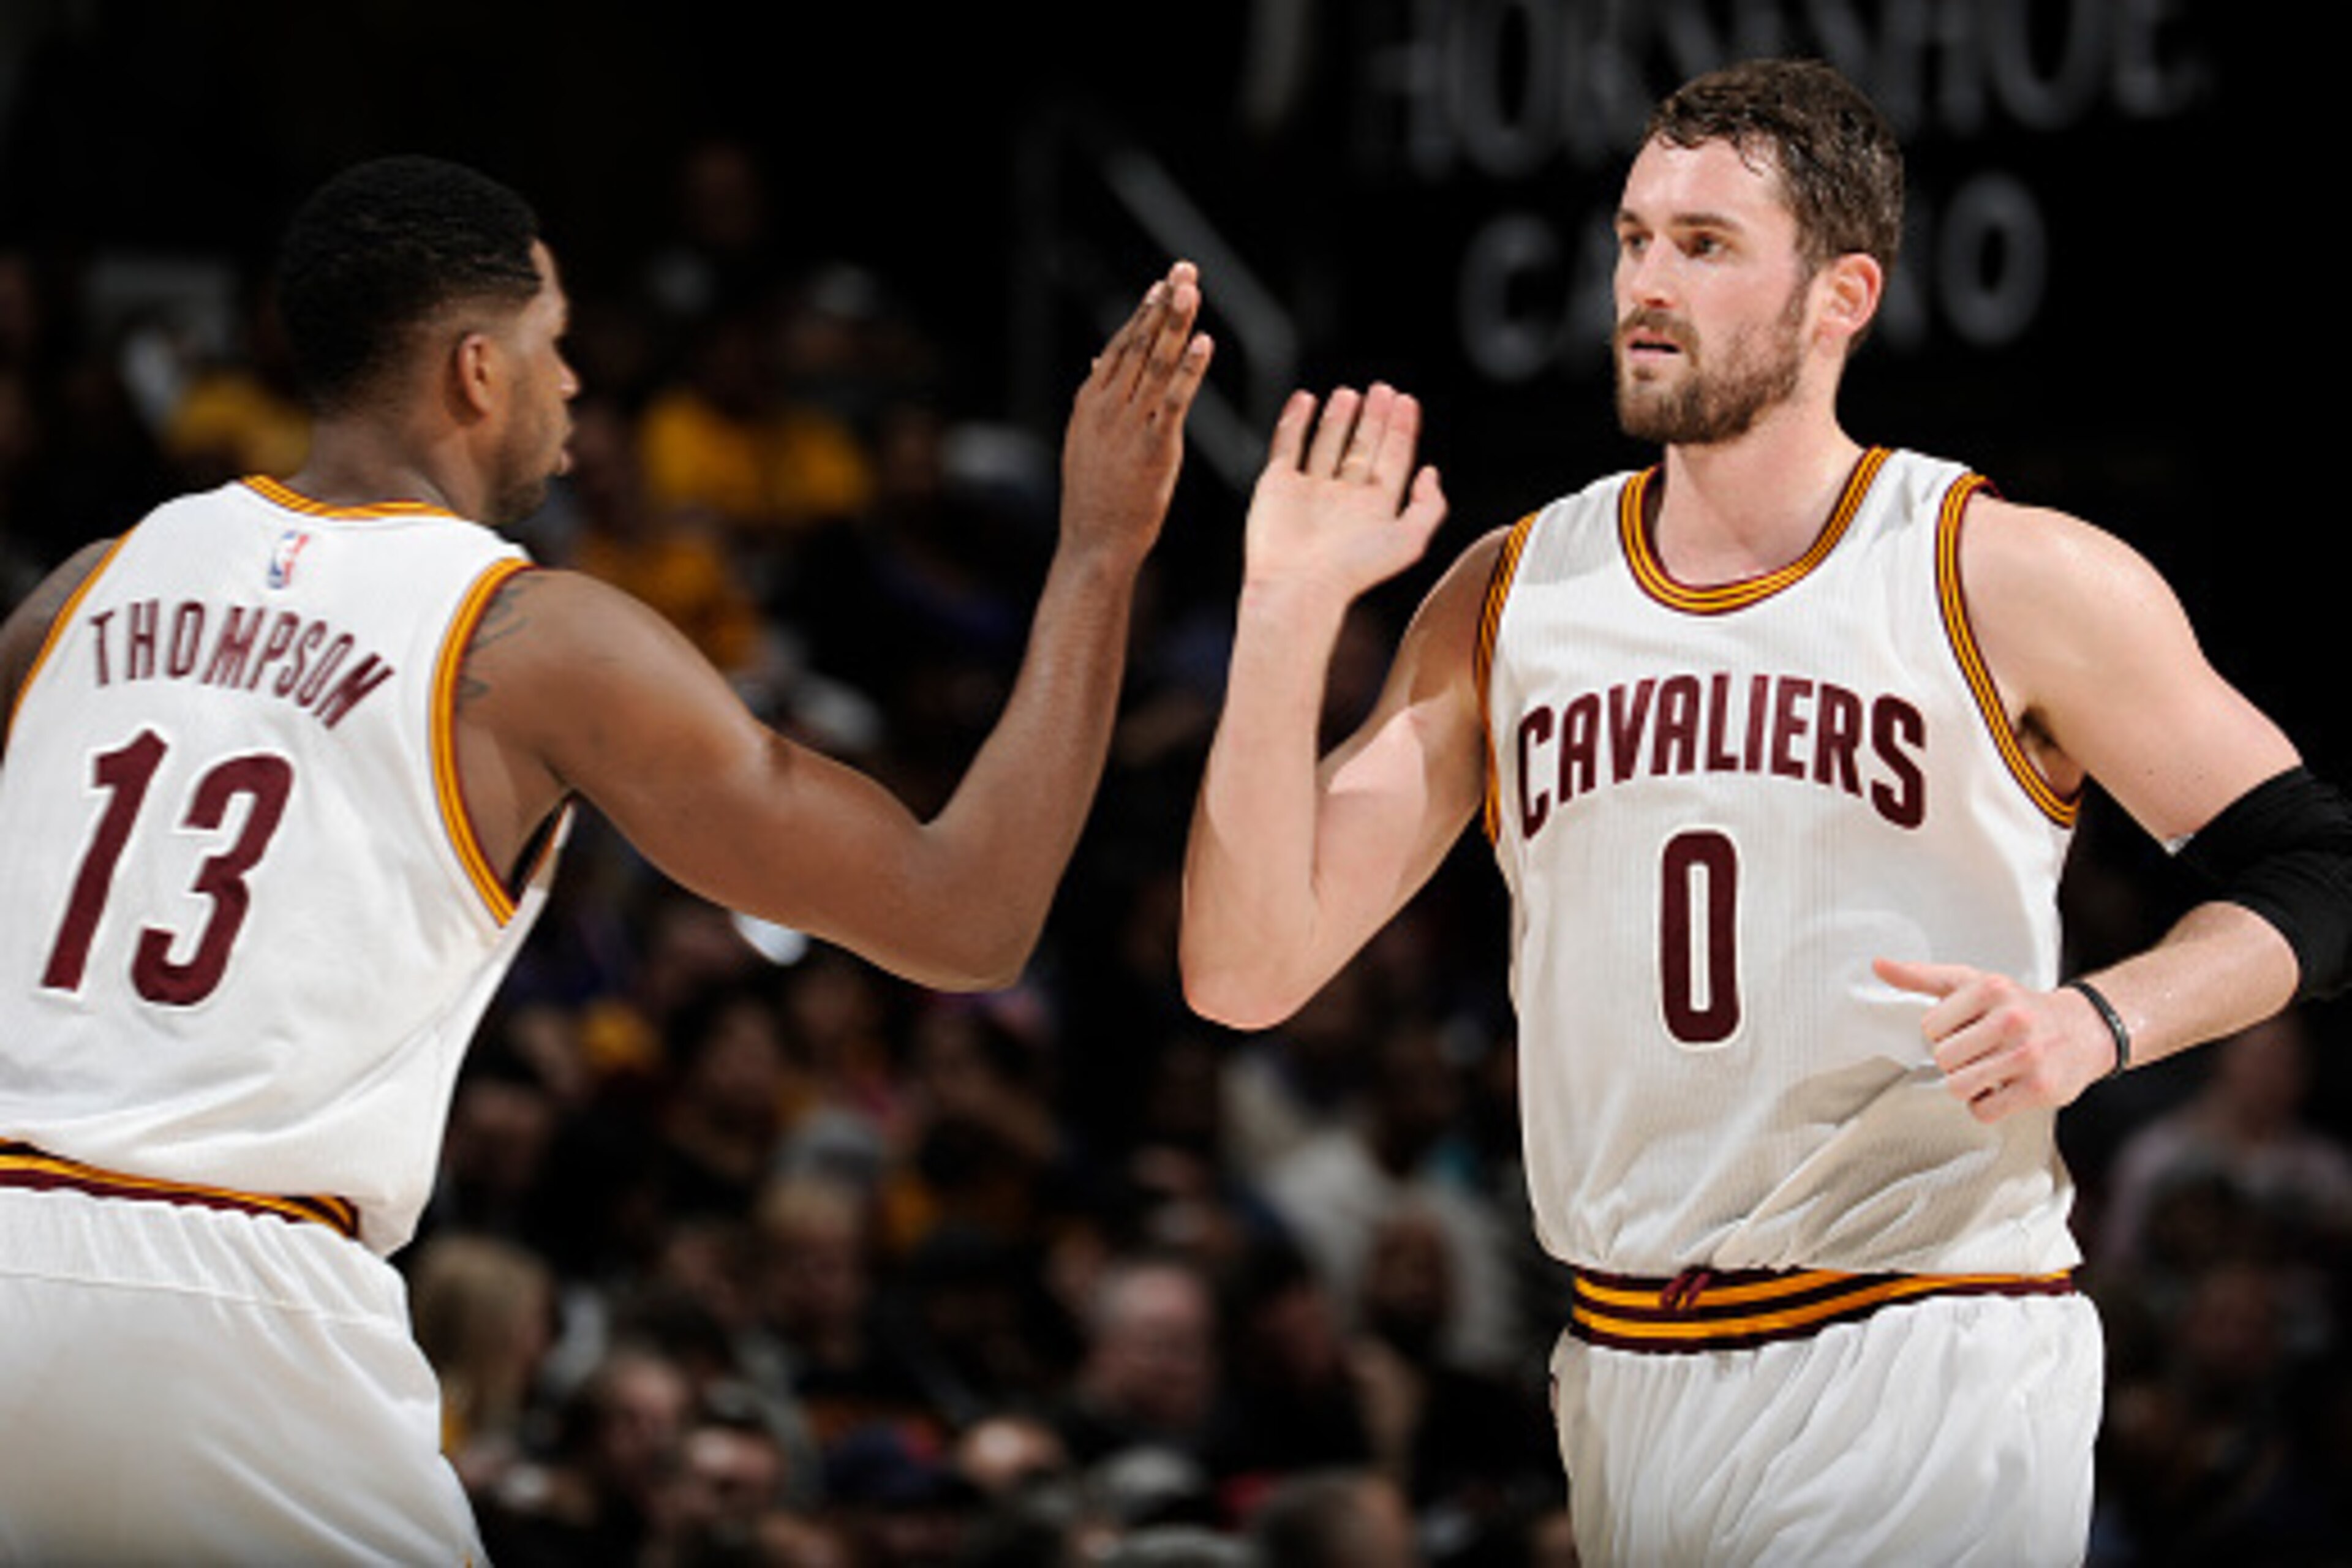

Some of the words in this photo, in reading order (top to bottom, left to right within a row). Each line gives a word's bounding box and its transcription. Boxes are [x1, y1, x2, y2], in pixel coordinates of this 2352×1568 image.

[89, 599, 396, 730] THOMPSON
[1516, 673, 1926, 840] CAVALIERS
[39, 728, 295, 1008] 13
[1660, 829, 1741, 1044] 0
